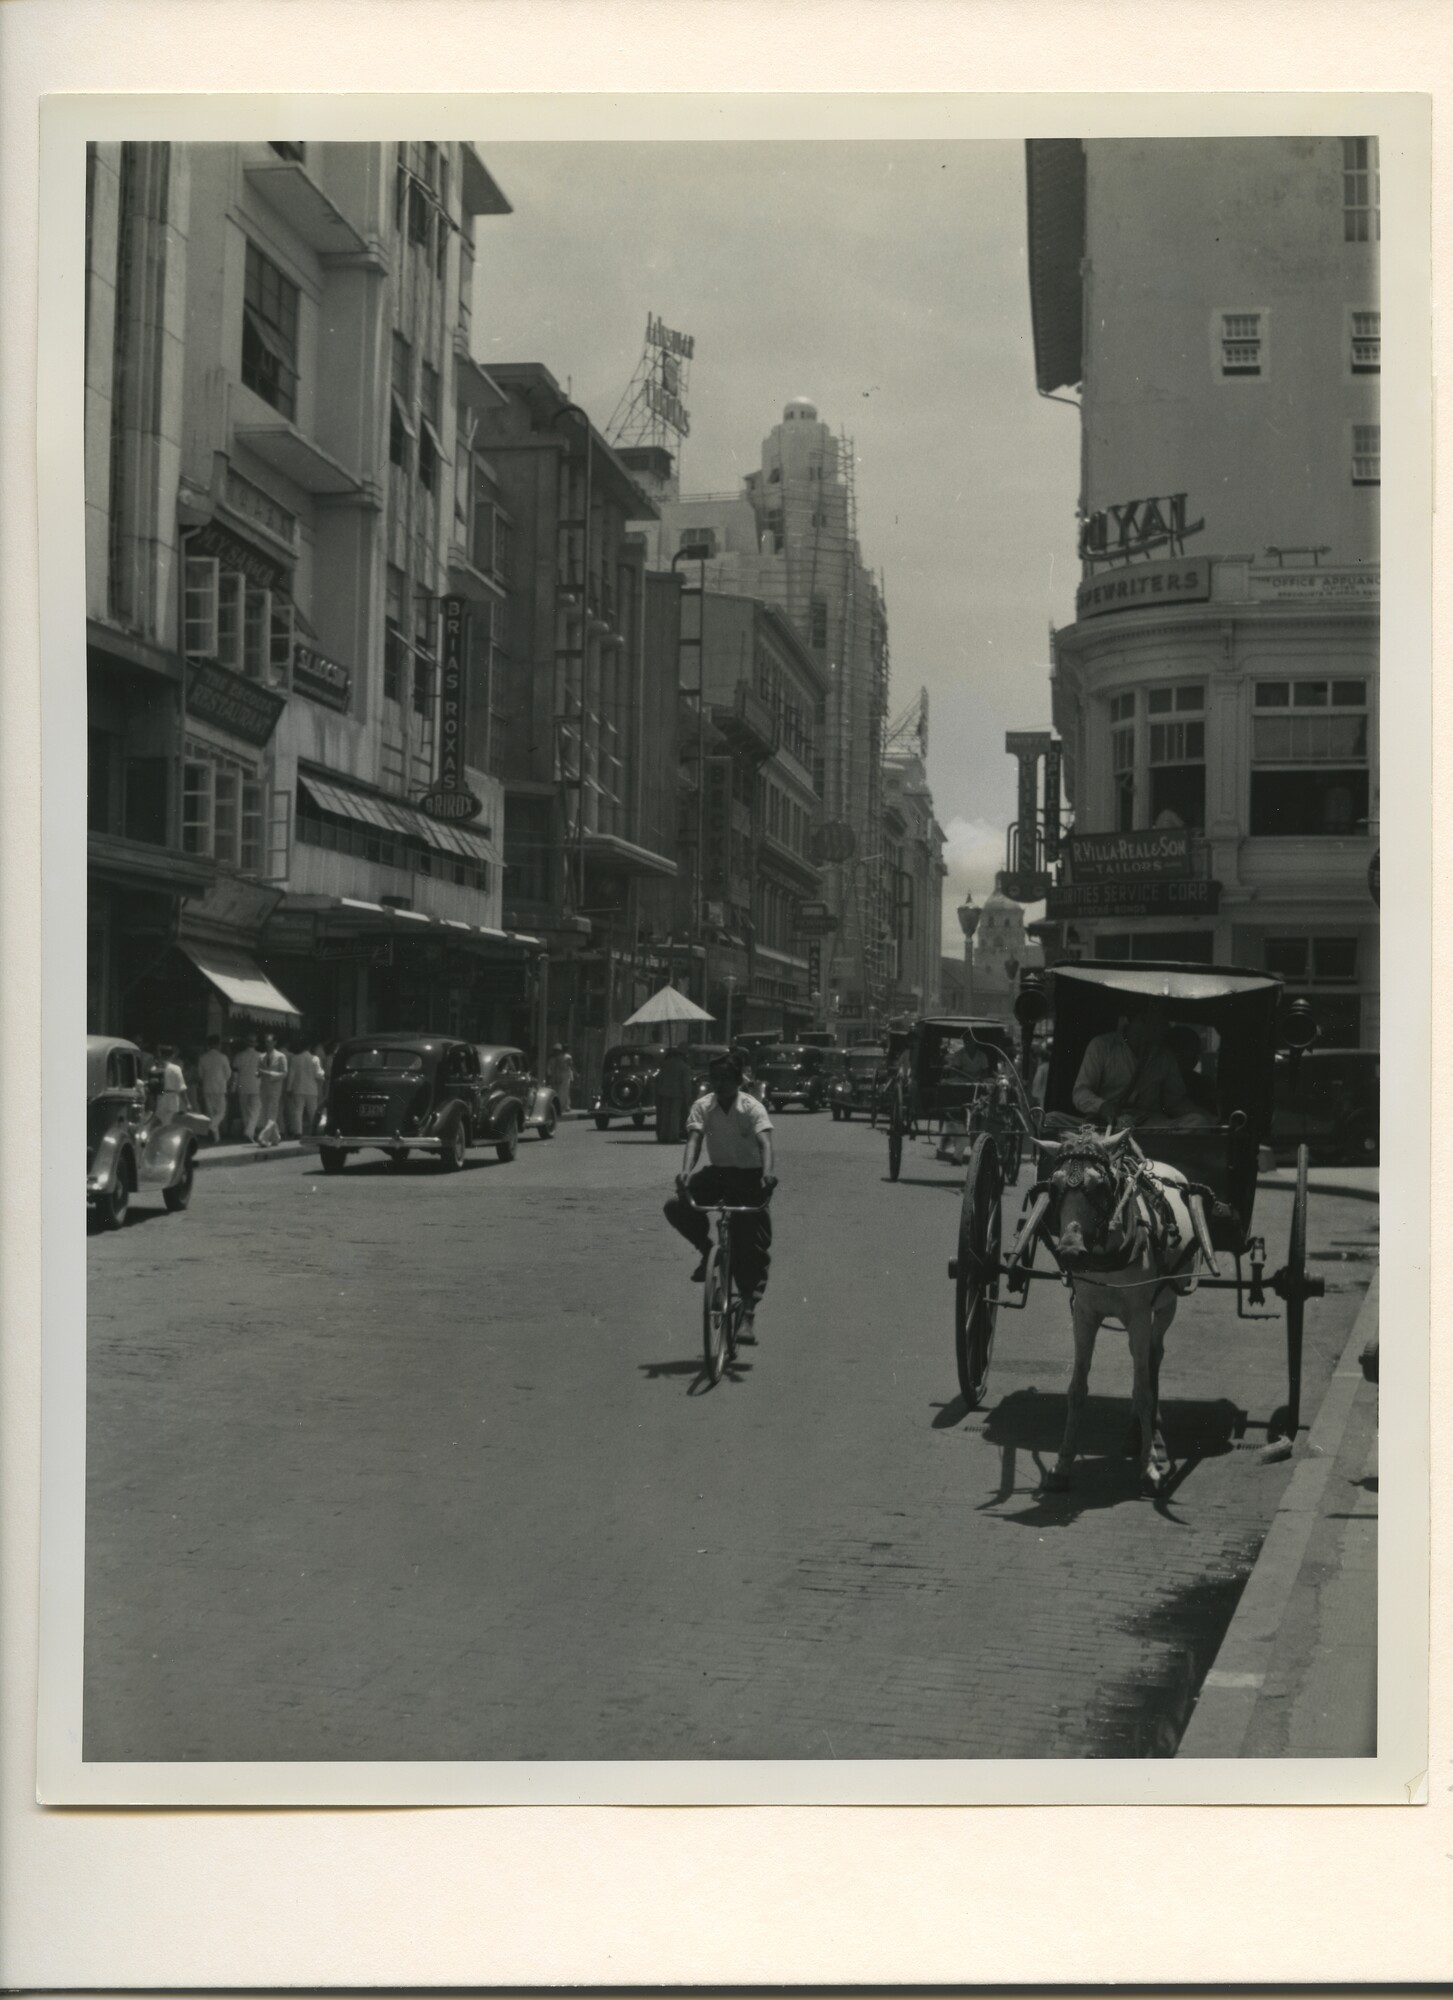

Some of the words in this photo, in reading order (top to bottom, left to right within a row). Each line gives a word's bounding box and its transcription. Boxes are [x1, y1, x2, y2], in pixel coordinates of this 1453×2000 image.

[1273, 577, 1315, 587] OFFICE
[447, 601, 461, 689] BRIAS
[189, 683, 271, 736] RESTAURANT
[443, 701, 459, 789] ROXAS
[426, 793, 472, 819] BRIROX
[1096, 861, 1162, 874] TAILORS
[1104, 884, 1160, 902] SERVICE
